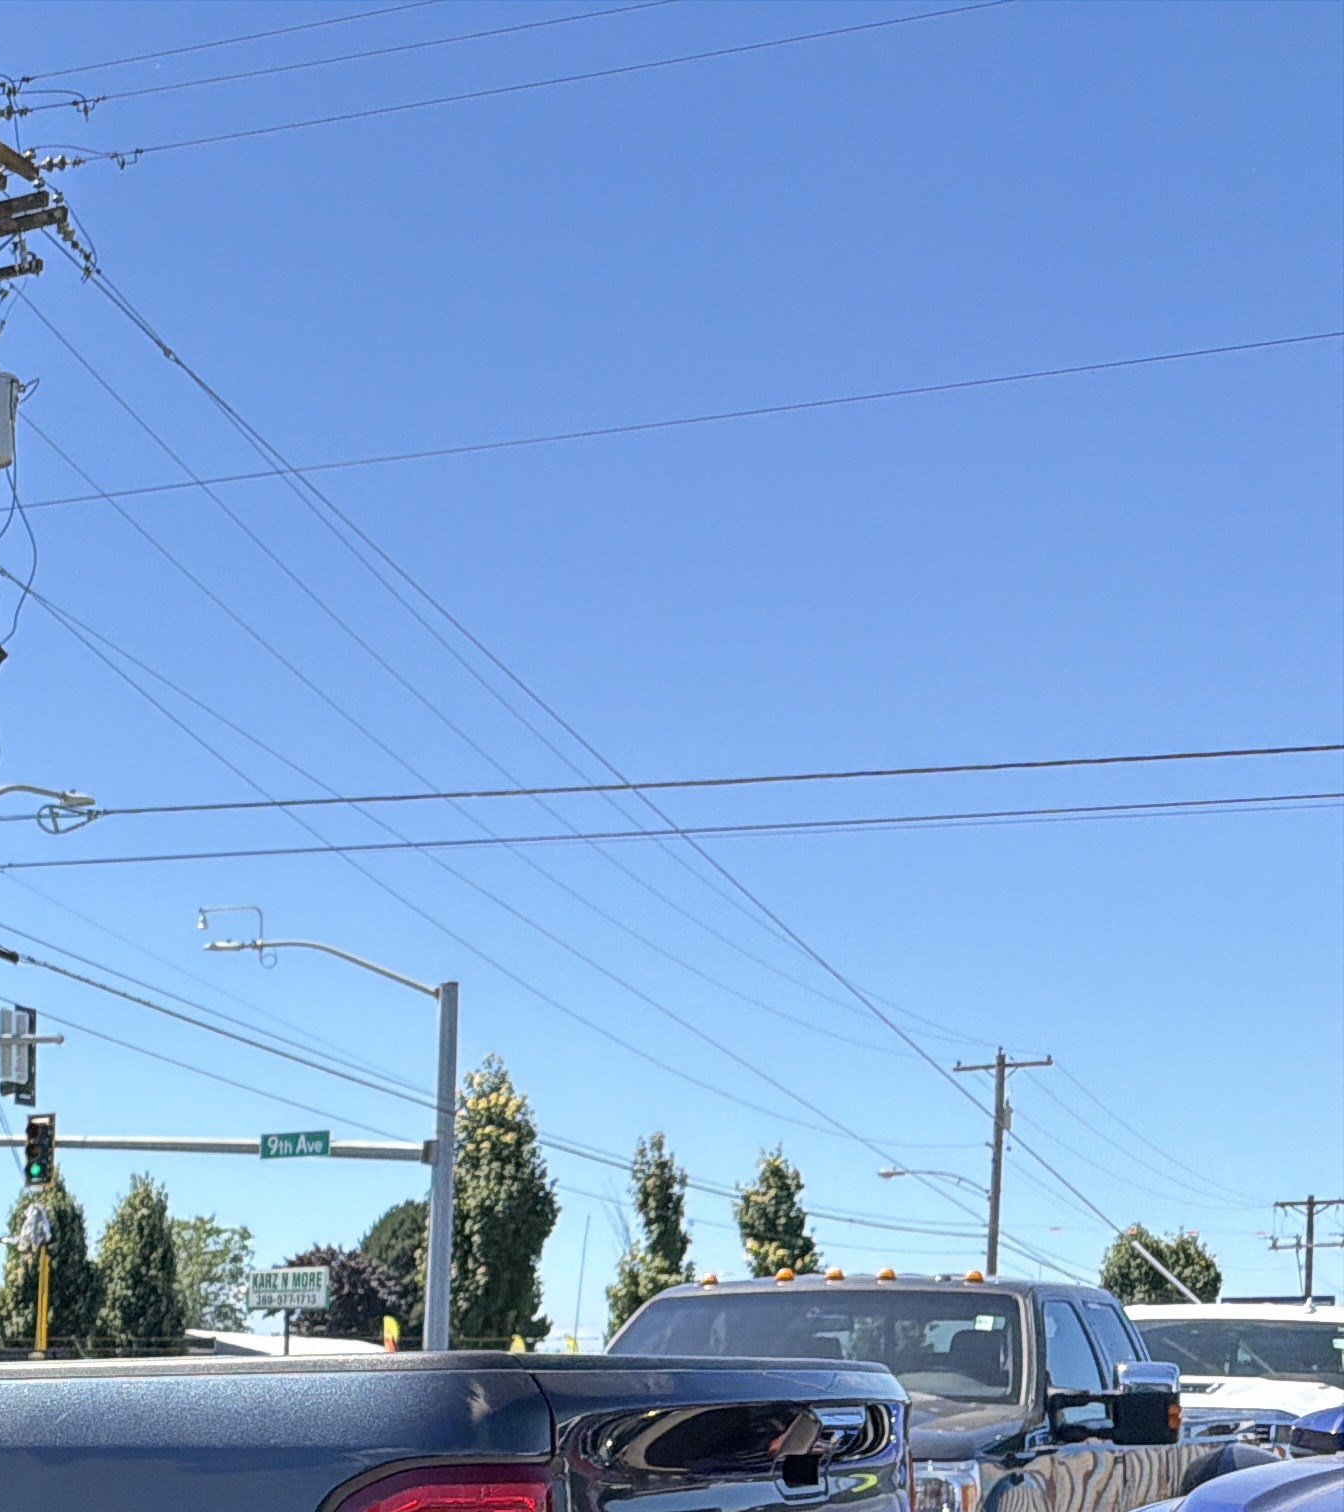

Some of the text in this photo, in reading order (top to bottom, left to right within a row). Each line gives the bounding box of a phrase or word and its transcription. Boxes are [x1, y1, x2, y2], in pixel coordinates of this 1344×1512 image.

[267, 1134, 323, 1156] 9th Ave
[252, 1271, 323, 1290] KARZ N MORE
